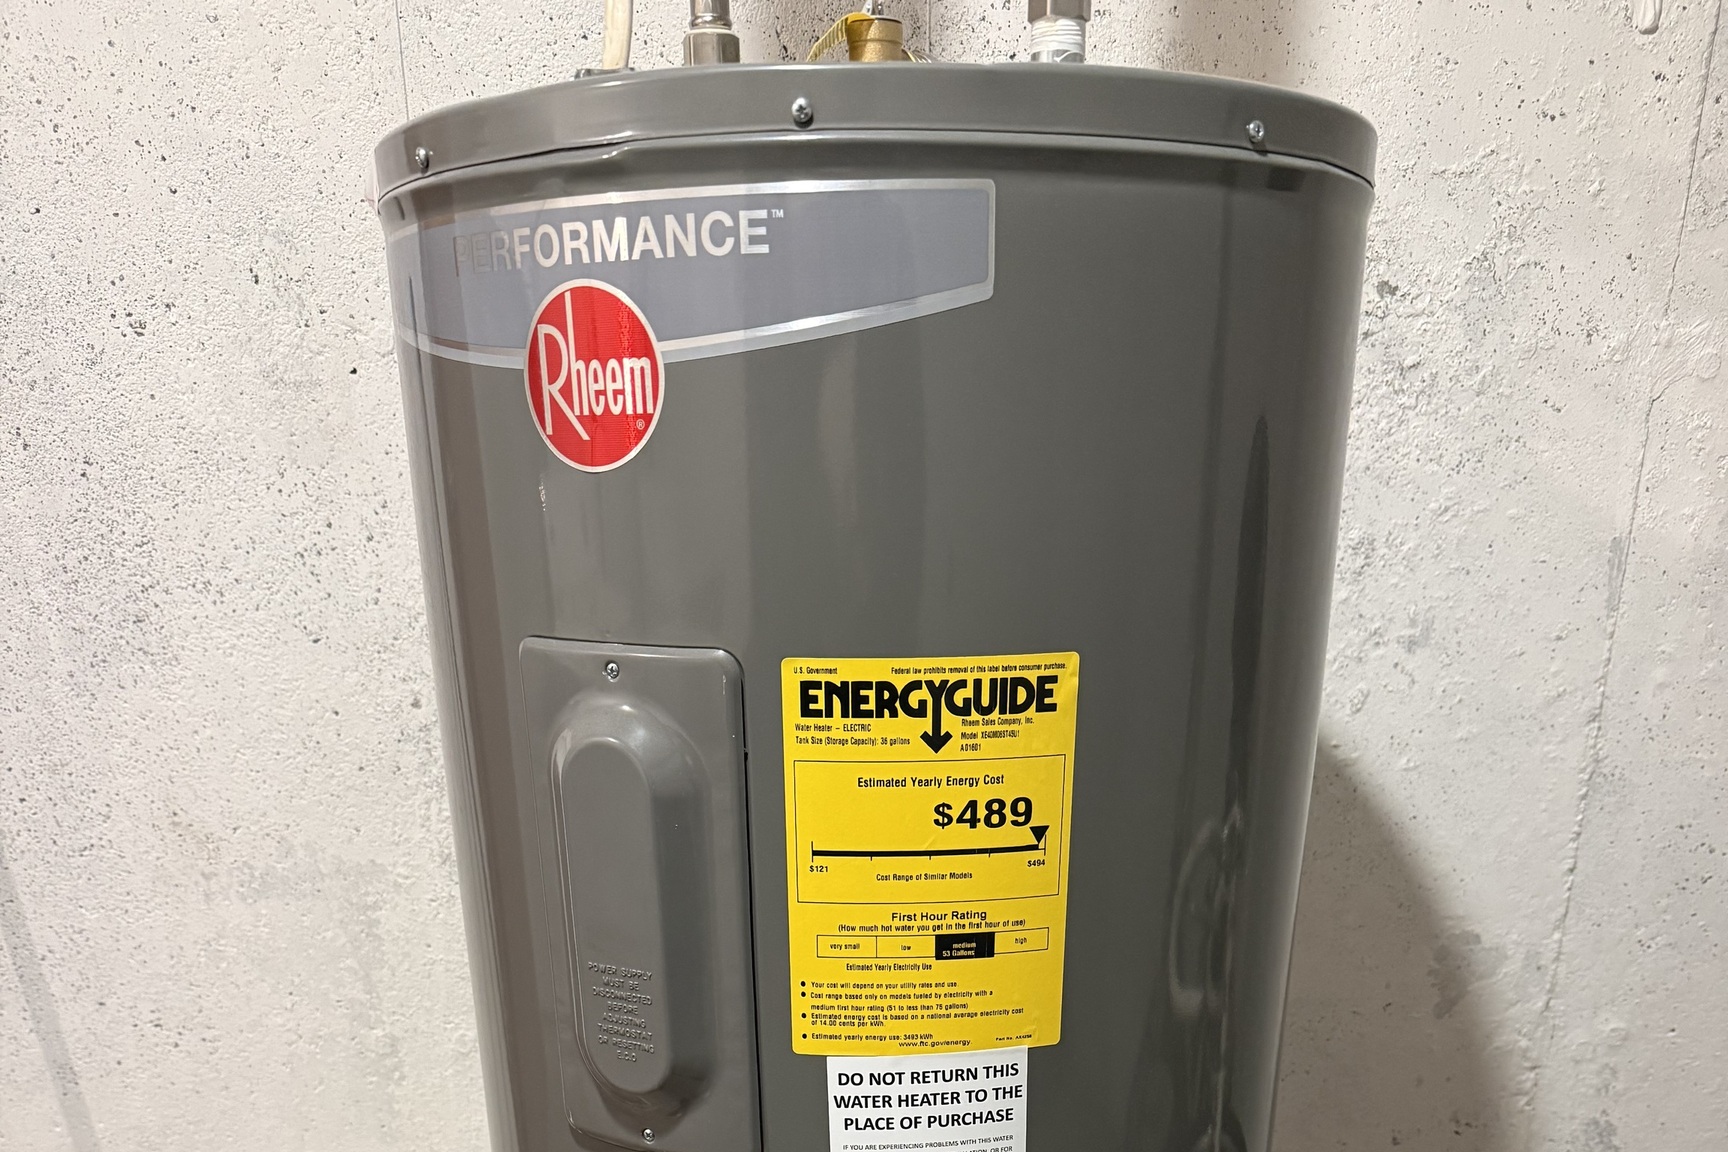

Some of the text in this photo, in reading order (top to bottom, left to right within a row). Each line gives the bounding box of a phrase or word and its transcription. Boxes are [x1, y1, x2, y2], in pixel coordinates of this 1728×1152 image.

[537, 291, 654, 440] Rheem
[891, 667, 911, 675] Federal
[923, 666, 946, 675] prohibits
[948, 666, 968, 674] removal
[970, 665, 975, 673] of
[976, 665, 986, 673] this
[1002, 664, 1017, 672] before
[1043, 662, 1067, 671] purchase.
[800, 675, 1058, 719] ENERGYGUIDE
[962, 716, 1034, 726] Rheem Sales Company, Inc.
[795, 723, 871, 732] Water Heater ELECTRIC
[796, 736, 809, 745] Tank
[810, 736, 823, 744] Size
[824, 736, 849, 746] (Storage
[850, 736, 879, 746] Capacity):
[890, 737, 910, 746] gallons
[961, 732, 978, 740] Model
[857, 774, 1004, 788] Estimated Yearly Energy Cost
[933, 797, 1033, 829] $489
[809, 865, 829, 873] $121
[1027, 859, 1045, 867] $494
[893, 873, 913, 882] Range
[915, 873, 922, 881] of
[923, 872, 948, 880] Similar
[949, 871, 973, 879] Models
[891, 910, 987, 922] First Hour Rating
[838, 919, 1026, 933] (How much hot water you get in the first hour of use)
[830, 942, 860, 951] very small
[953, 941, 976, 949] medium
[1014, 936, 1028, 945] high
[952, 949, 975, 957] Gallons
[588, 961, 652, 981] POWER SUPPLY
[846, 963, 873, 971] Estimated
[874, 963, 892, 972] Yearly
[893, 963, 920, 972] Electricity
[811, 981, 825, 989] Your
[852, 982, 874, 990] depend
[592, 986, 652, 1005] DISCONNECTED
[607, 1001, 638, 1015] BEFORE
[838, 1063, 1019, 1086] DO NOT RETURN THIS
[833, 1085, 1023, 1109] WATER HEATER TO THE
[844, 1108, 1014, 1131] PLACE OF PURCHASE
[878, 1142, 924, 1150] EXPERIENCING
[925, 1140, 959, 1149] PROBLEMS
[960, 1138, 977, 1146] WITH
[992, 1135, 1014, 1143] WATER
